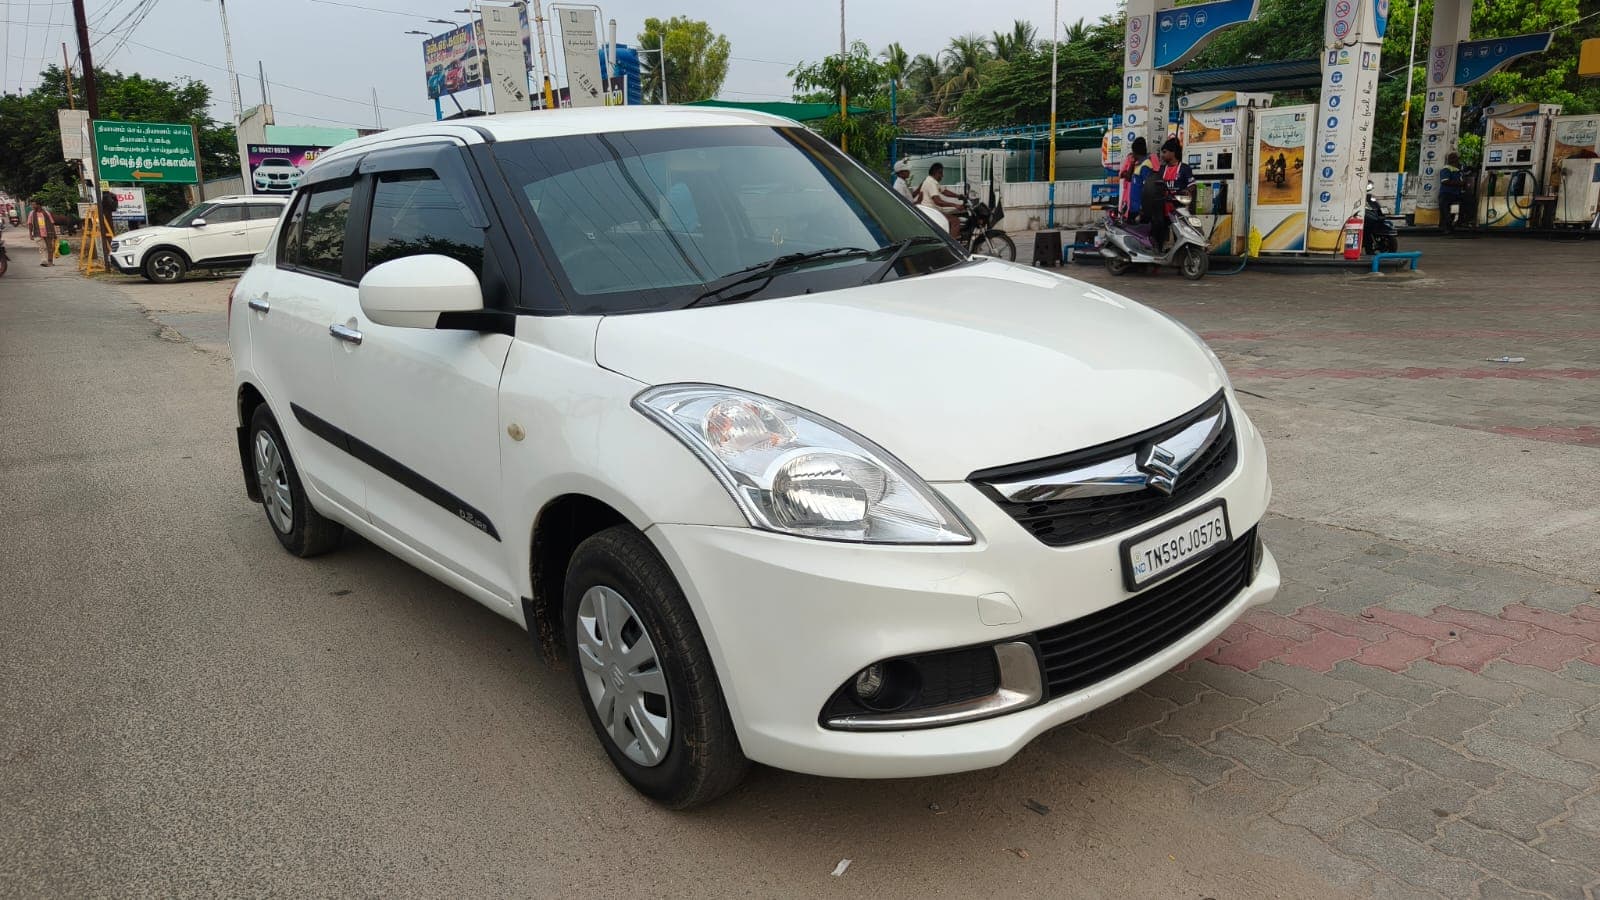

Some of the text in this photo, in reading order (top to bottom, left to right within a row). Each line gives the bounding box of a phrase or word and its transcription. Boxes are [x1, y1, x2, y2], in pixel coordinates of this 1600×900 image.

[1163, 42, 1167, 56] 1
[1462, 67, 1470, 78] 3
[1144, 518, 1222, 571] TN59CJ0576
